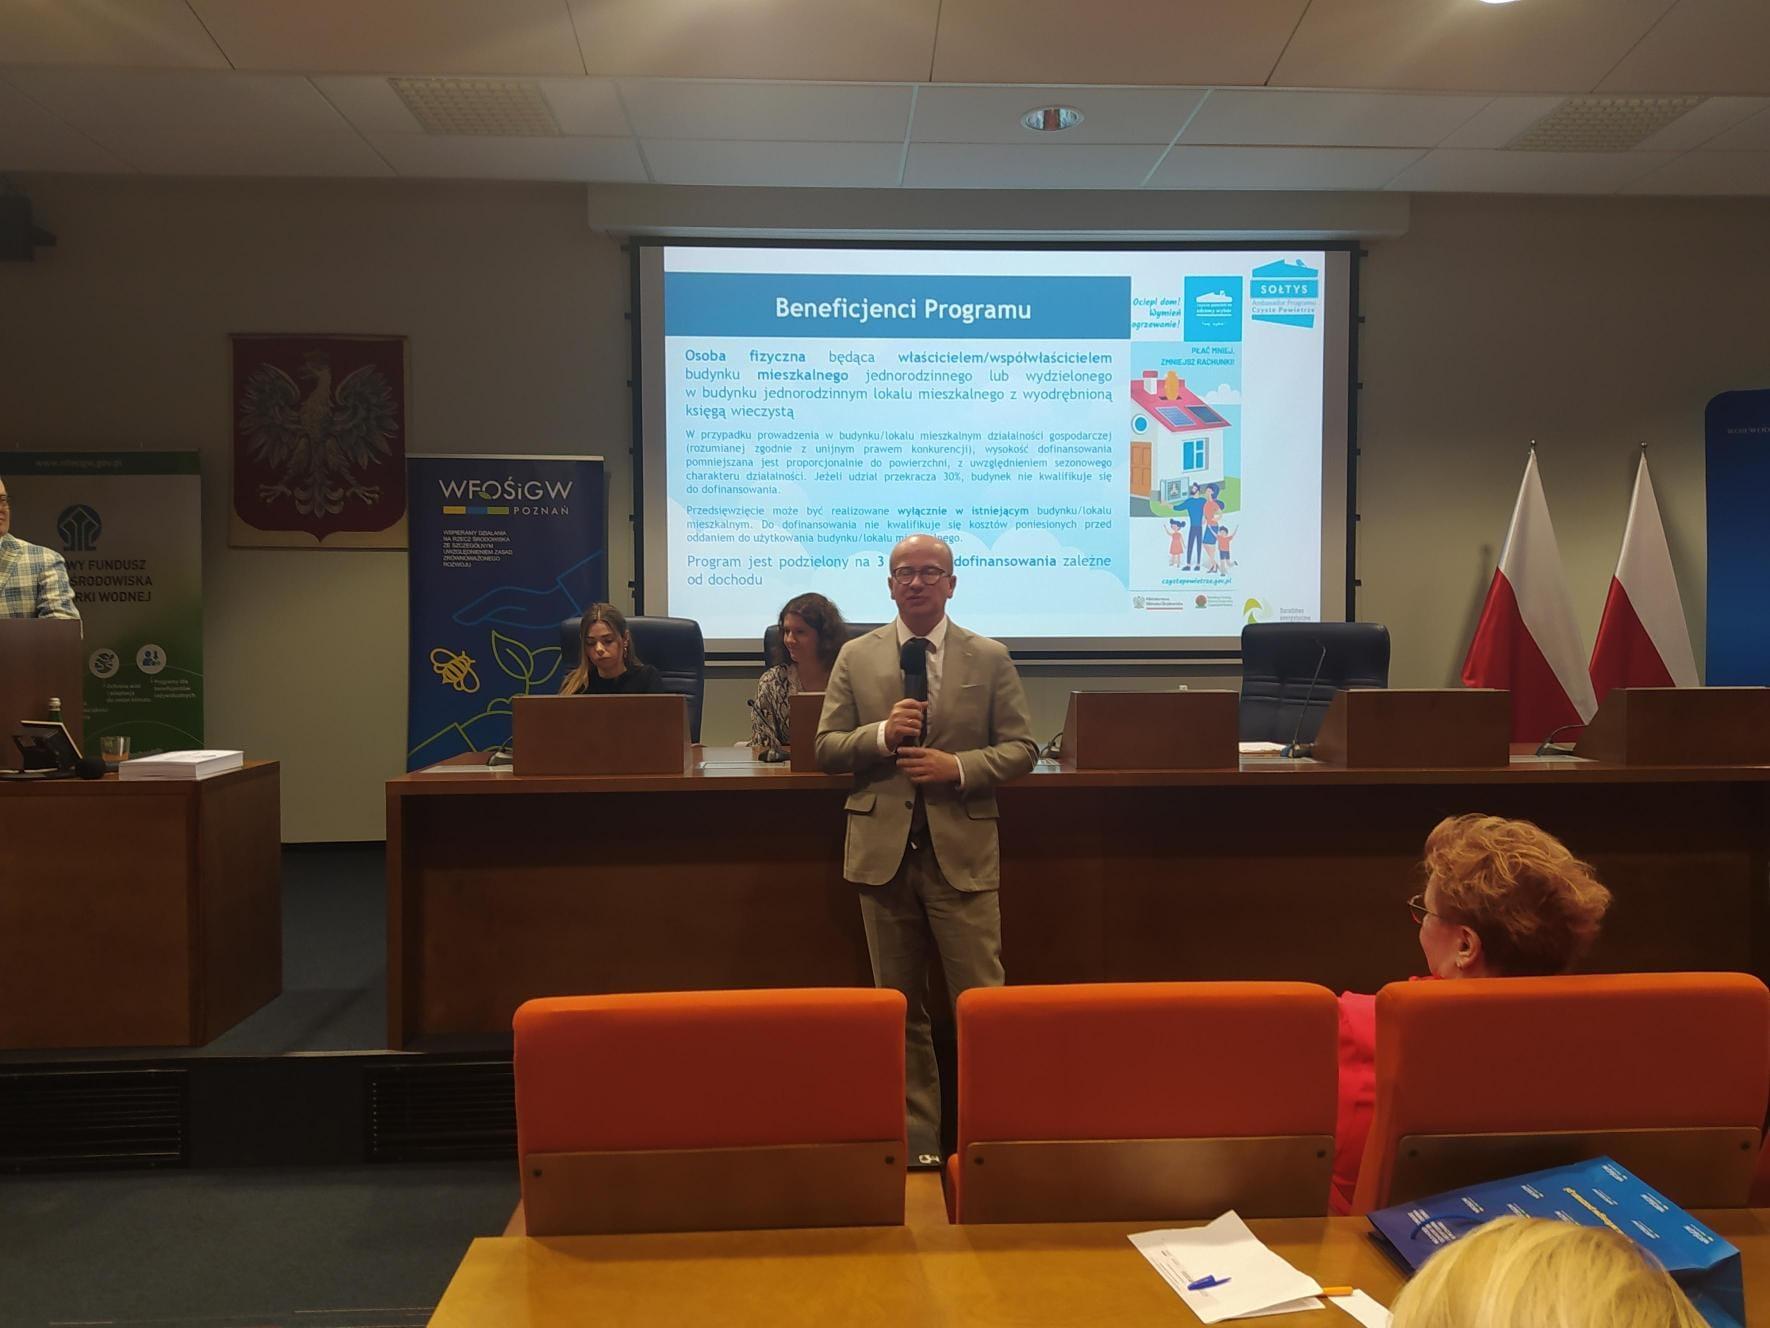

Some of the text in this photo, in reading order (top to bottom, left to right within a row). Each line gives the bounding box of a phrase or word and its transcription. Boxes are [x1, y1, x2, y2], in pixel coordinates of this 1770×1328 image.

[1260, 284, 1308, 294] SOŁTYS
[776, 297, 1031, 324] Beneficjenci Programu
[684, 349, 1112, 366] Osoba fizyczna będąca właścicielem/współwłaścicielem
[685, 368, 1112, 385] budynku mieszkalnego jednorodzinnego lub wydzielonego
[685, 386, 1113, 403] w budynku jednorodzinnym lokalu mieszkalnego z wyodrębnioną
[685, 404, 795, 420] księgą wieczystą
[685, 430, 695, 439] W
[700, 430, 751, 441] przypadku
[757, 431, 819, 441] prowadzenia
[839, 431, 914, 441] budynku/lokalu
[920, 432, 981, 441] mieszkalnym
[986, 431, 1043, 440] działalności
[1048, 431, 1111, 442] gospodarczej
[686, 444, 745, 454] (rozumianej
[754, 444, 792, 455] zgodnie
[815, 444, 854, 455] unijnym
[863, 446, 902, 455] prawem
[984, 444, 1028, 455] wysokość
[1037, 444, 1112, 453] dofinansowania
[685, 457, 753, 468] pomniejszana
[761, 458, 779, 468] jest
[786, 458, 863, 469] proporcjonalnie
[870, 459, 882, 467] do
[969, 459, 1047, 469] uwzględnieniem
[1054, 460, 1112, 469] sezonowego
[685, 471, 739, 480] charakteru
[813, 472, 842, 481] Jeżeli
[848, 472, 877, 481] udział
[883, 472, 936, 482] przekracza
[970, 472, 1011, 483] budynek
[1017, 472, 1032, 480] nie
[1039, 472, 1092, 482] kwalifikuje
[1098, 472, 1112, 482] się
[439, 476, 573, 500] WFOŚiGW
[686, 485, 698, 493] do
[513, 505, 569, 515] POZNAŃ
[686, 506, 764, 517] Przedsięwzięcie
[772, 504, 798, 515] może
[806, 506, 823, 516] być
[831, 506, 889, 515] realizowane
[896, 506, 947, 517] wyłącznie
[971, 506, 1029, 517] istniejącym
[1036, 506, 1111, 516] budynku/lokalu
[761, 520, 774, 528] Do
[781, 520, 856, 529] dofinansowania
[864, 521, 879, 529] nie
[887, 520, 940, 531] kwalifikuje
[947, 520, 961, 530] się
[968, 520, 1008, 529] kosztów
[1015, 520, 1077, 530] poniesionych
[1084, 520, 1111, 529] przed
[686, 533, 734, 542] oddaniem
[737, 534, 750, 542] do
[753, 534, 814, 544] użytkowania
[817, 533, 892, 544] budynku/lokalu
[89, 560, 146, 570] FUNDUSZ
[687, 555, 1111, 570] Program jest podzielony na 3 dofinansowania zależne
[687, 573, 762, 585] od dochodu
[99, 591, 151, 602] WODNEJ
